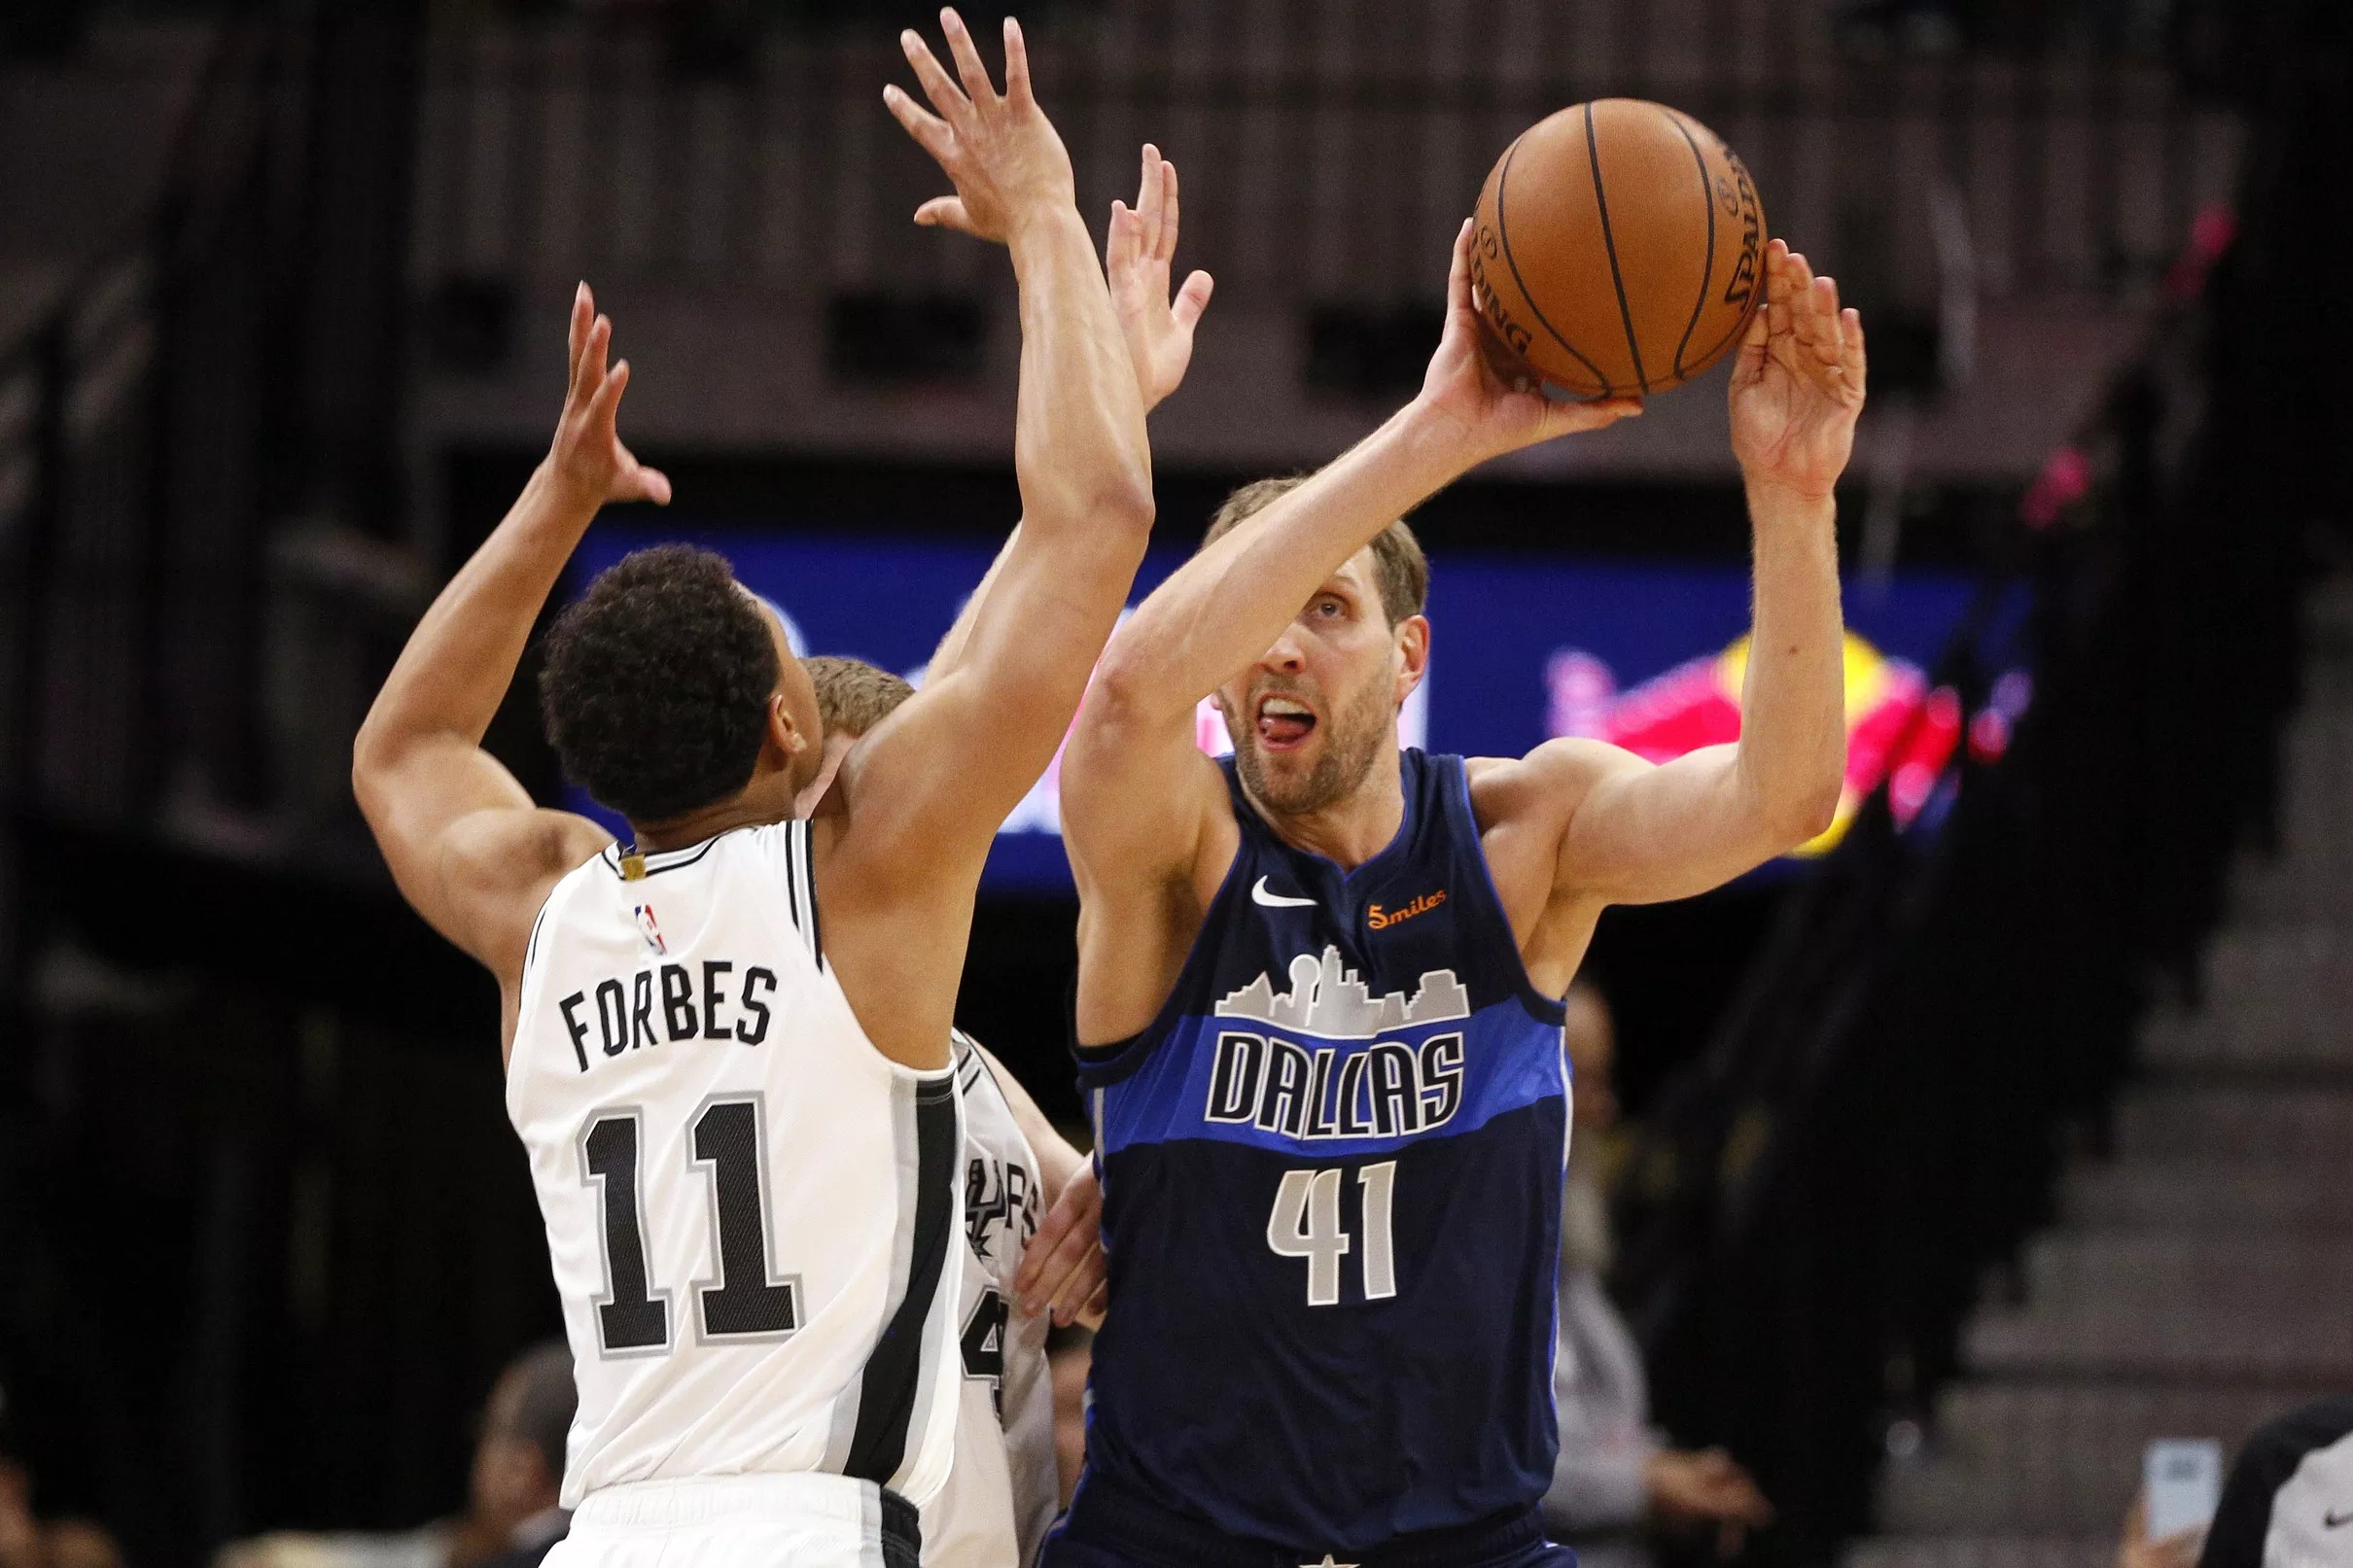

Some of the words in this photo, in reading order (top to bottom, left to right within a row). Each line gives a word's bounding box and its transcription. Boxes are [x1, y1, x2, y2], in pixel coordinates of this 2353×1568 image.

[559, 959, 778, 1072] FORBES
[1204, 1030, 1465, 1140] DALLAS
[576, 1090, 806, 1361] 11
[1266, 1160, 1397, 1307] 41
